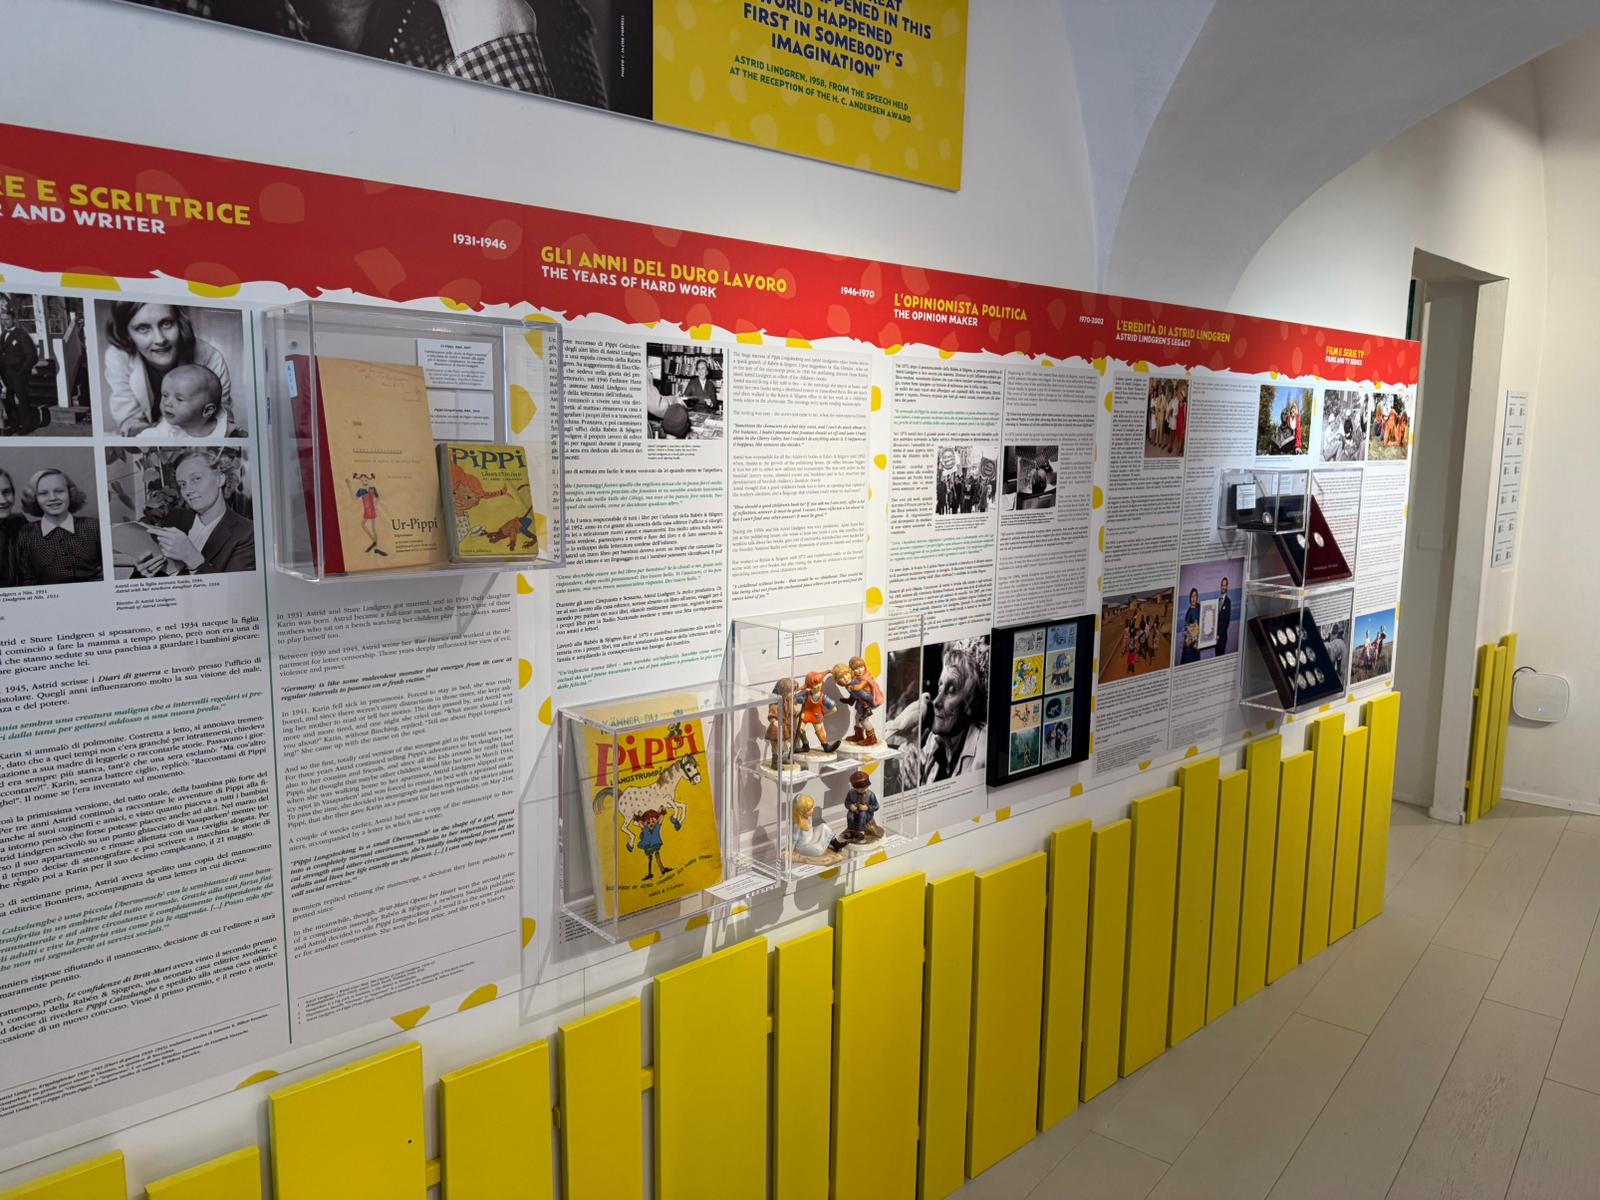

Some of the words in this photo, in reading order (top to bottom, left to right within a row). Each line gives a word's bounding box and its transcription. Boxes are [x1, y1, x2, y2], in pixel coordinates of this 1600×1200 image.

[744, 2, 789, 31] FIRST
[795, 20, 810, 37] IN
[815, 29, 903, 67] SOMEBODY'S
[818, 8, 892, 44] HAPPENED
[884, 11, 898, 28] IN
[902, 17, 931, 39] THIS
[730, 66, 741, 74] AT
[742, 69, 758, 80] THE
[760, 74, 804, 93] RECEPTION
[805, 87, 815, 96] OF
[816, 90, 832, 101] THE
[850, 100, 886, 115] ANDERSEN
[887, 110, 912, 122] AWARD
[735, 55, 765, 69] ASTRID
[766, 63, 807, 83] LINDGREN,
[809, 76, 826, 88] 1958,
[828, 81, 850, 93] FROM
[851, 87, 865, 97] THE
[866, 92, 892, 106] SPEECH
[892, 100, 909, 110] HELD
[37, 179, 57, 202] E
[69, 184, 251, 226] SCRITTRICE
[11, 203, 66, 222] AND
[73, 210, 166, 234] WRITER
[453, 234, 506, 250] 1931-1946
[540, 246, 572, 266] GLI
[578, 251, 627, 272] ANNI
[634, 259, 665, 278] DEL
[671, 263, 719, 284] DURO
[724, 269, 786, 293] LAVORO
[541, 265, 568, 280] THE
[571, 269, 616, 286] YEARS
[621, 275, 638, 288] OF
[641, 278, 676, 293] HARD
[679, 282, 717, 298] WORK
[840, 287, 874, 298] 1946-1970
[894, 293, 978, 315] L'OPINIONISTA
[982, 304, 1027, 320] POLITICA
[894, 309, 910, 319] THE
[911, 311, 948, 322] OPINION
[948, 315, 978, 326] MAKER
[1080, 316, 1104, 326] 1970-2002
[1158, 325, 1166, 335] DI
[1168, 327, 1195, 338] ASTRID
[1197, 330, 1231, 342] LINDGREN
[1171, 339, 1191, 347] LEGACY
[392, 517, 438, 532] Ur-Pippi
[56, 632, 95, 643] Lindgren
[181, 621, 199, 629] 1934
[241, 616, 259, 625] figlia
[32, 680, 58, 690] Astrid
[98, 674, 121, 682] Diari
[133, 670, 161, 679] guerra
[171, 665, 196, 673] lavorò
[198, 663, 222, 672] presso
[8, 898, 17, 906] di
[20, 890, 62, 903] settimane
[94, 876, 119, 887] Astrid
[121, 872, 144, 881] aveva
[146, 865, 175, 878] spedito
[194, 856, 214, 867] copia
[216, 851, 229, 859] del
[231, 844, 272, 856] manoscritto
